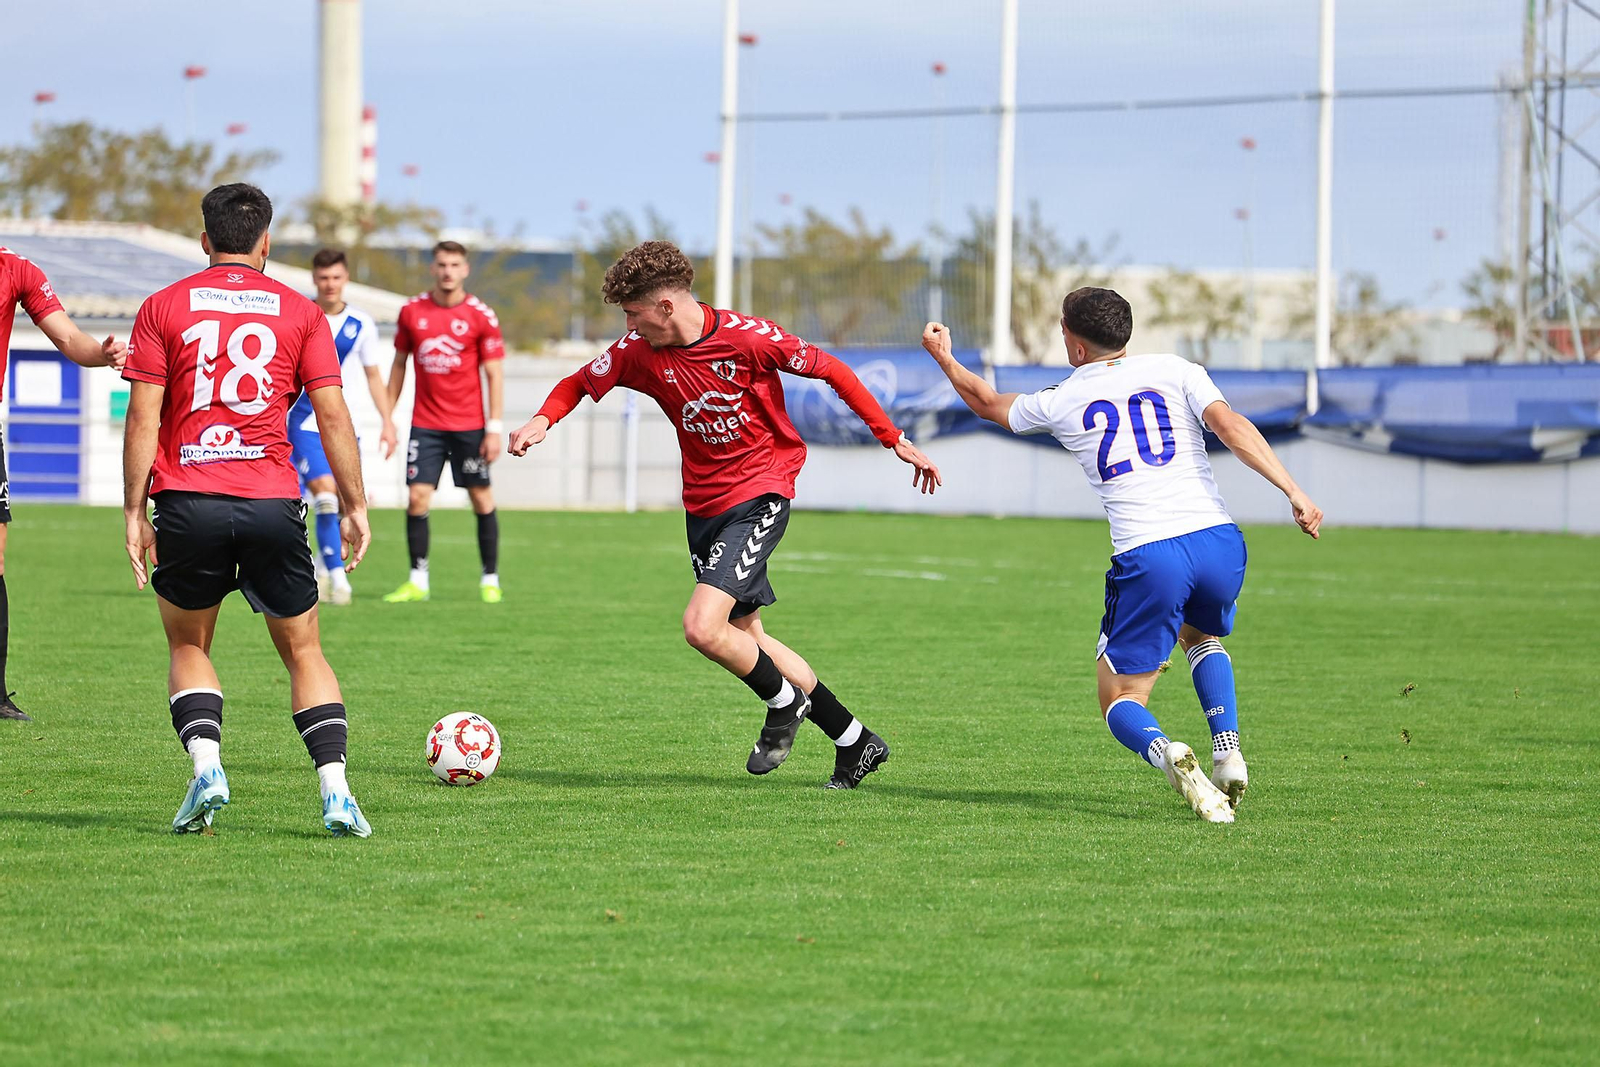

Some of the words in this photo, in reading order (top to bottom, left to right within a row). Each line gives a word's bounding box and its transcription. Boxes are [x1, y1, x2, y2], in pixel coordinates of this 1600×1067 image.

[194, 290, 228, 302] Doña
[231, 292, 276, 306] Gamba
[181, 319, 278, 416] 18
[682, 411, 751, 434] Garden
[701, 431, 741, 445] hotels
[1082, 390, 1176, 482] 20
